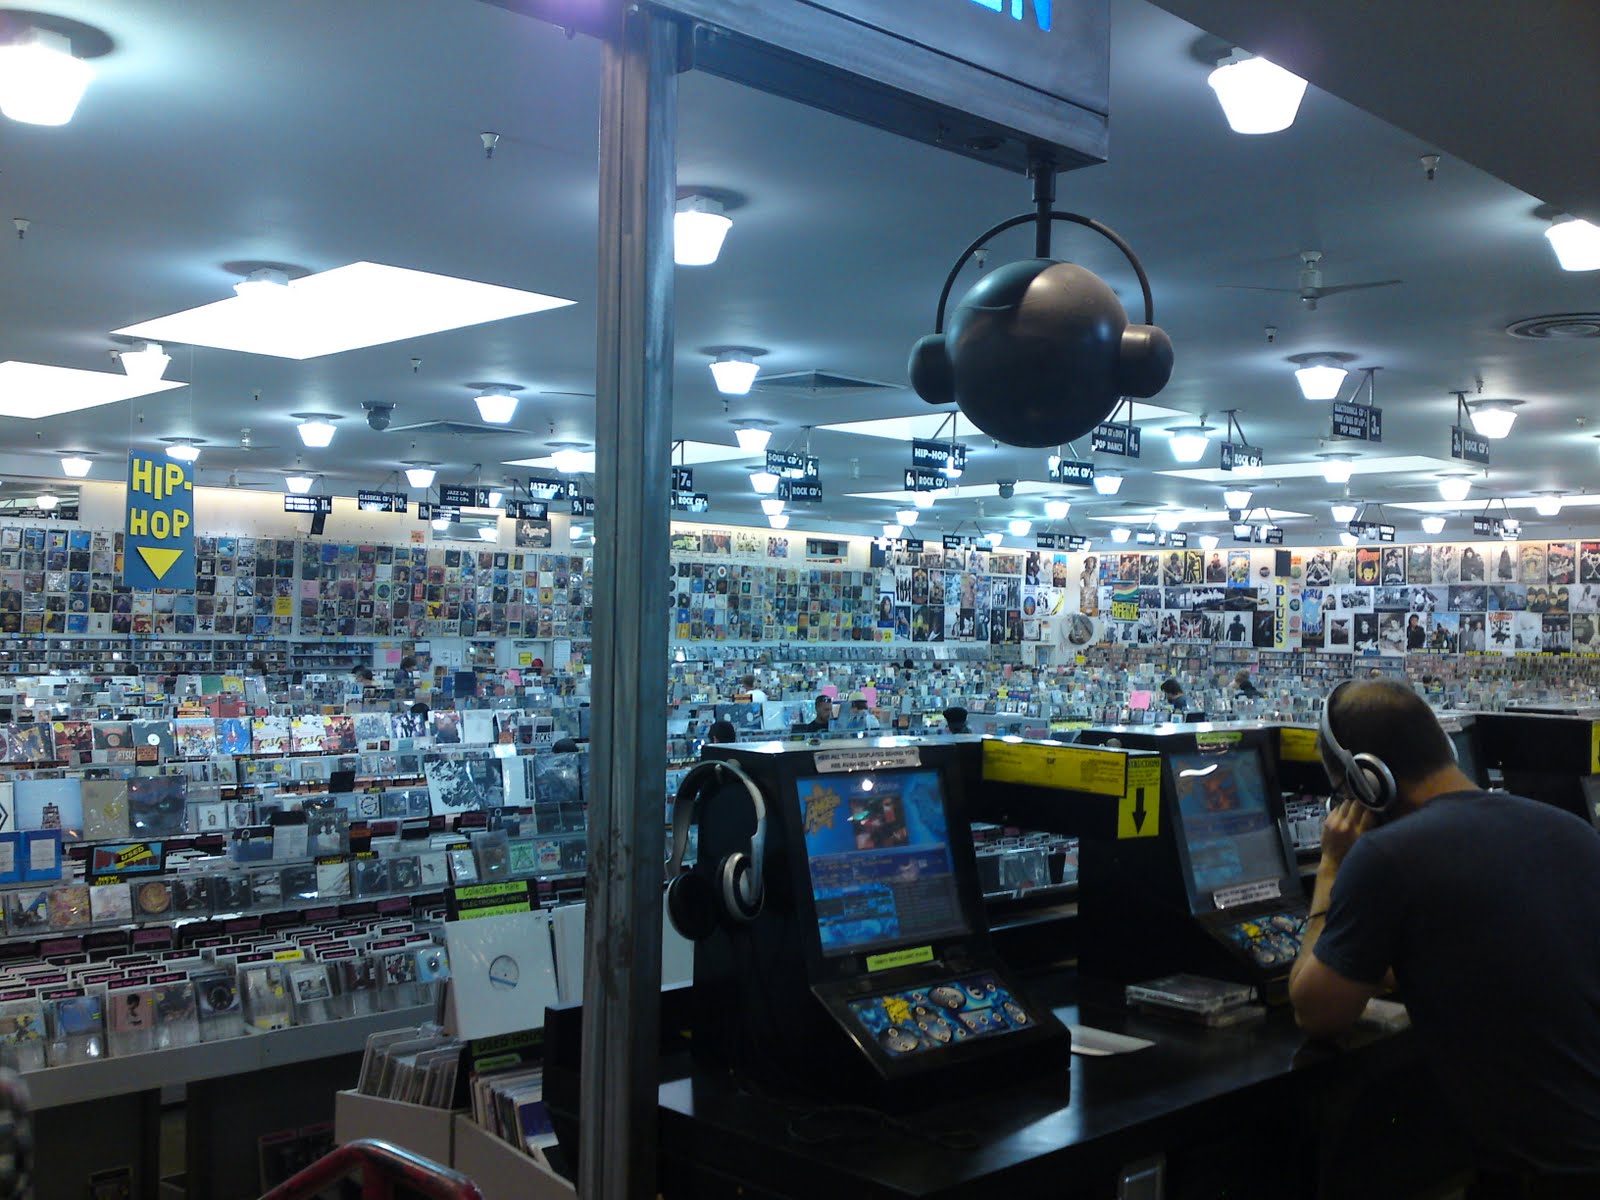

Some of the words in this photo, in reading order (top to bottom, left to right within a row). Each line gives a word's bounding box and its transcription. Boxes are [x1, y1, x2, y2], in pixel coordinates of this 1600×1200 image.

[1095, 439, 1106, 449] POP
[1108, 442, 1123, 452] DANCE
[768, 452, 785, 464] SOUL
[788, 455, 802, 466] CD's
[914, 448, 948, 460] HIP-HOP
[1234, 454, 1248, 466] ROCK
[1064, 466, 1080, 477] ROCK
[1081, 468, 1094, 478] CD's
[680, 472, 691, 487] 7a
[919, 476, 934, 486] ROCK
[936, 478, 948, 488] CD's
[530, 482, 548, 490] JAZZ
[549, 484, 564, 494] CD's
[792, 486, 808, 496] ROCK
[809, 487, 822, 496] CD's
[360, 494, 381, 502] CLASSICAL
[678, 496, 694, 506] ROCK
[130, 507, 190, 539] HOP
[1276, 585, 1286, 644] BLUES
[121, 846, 145, 861] USED
